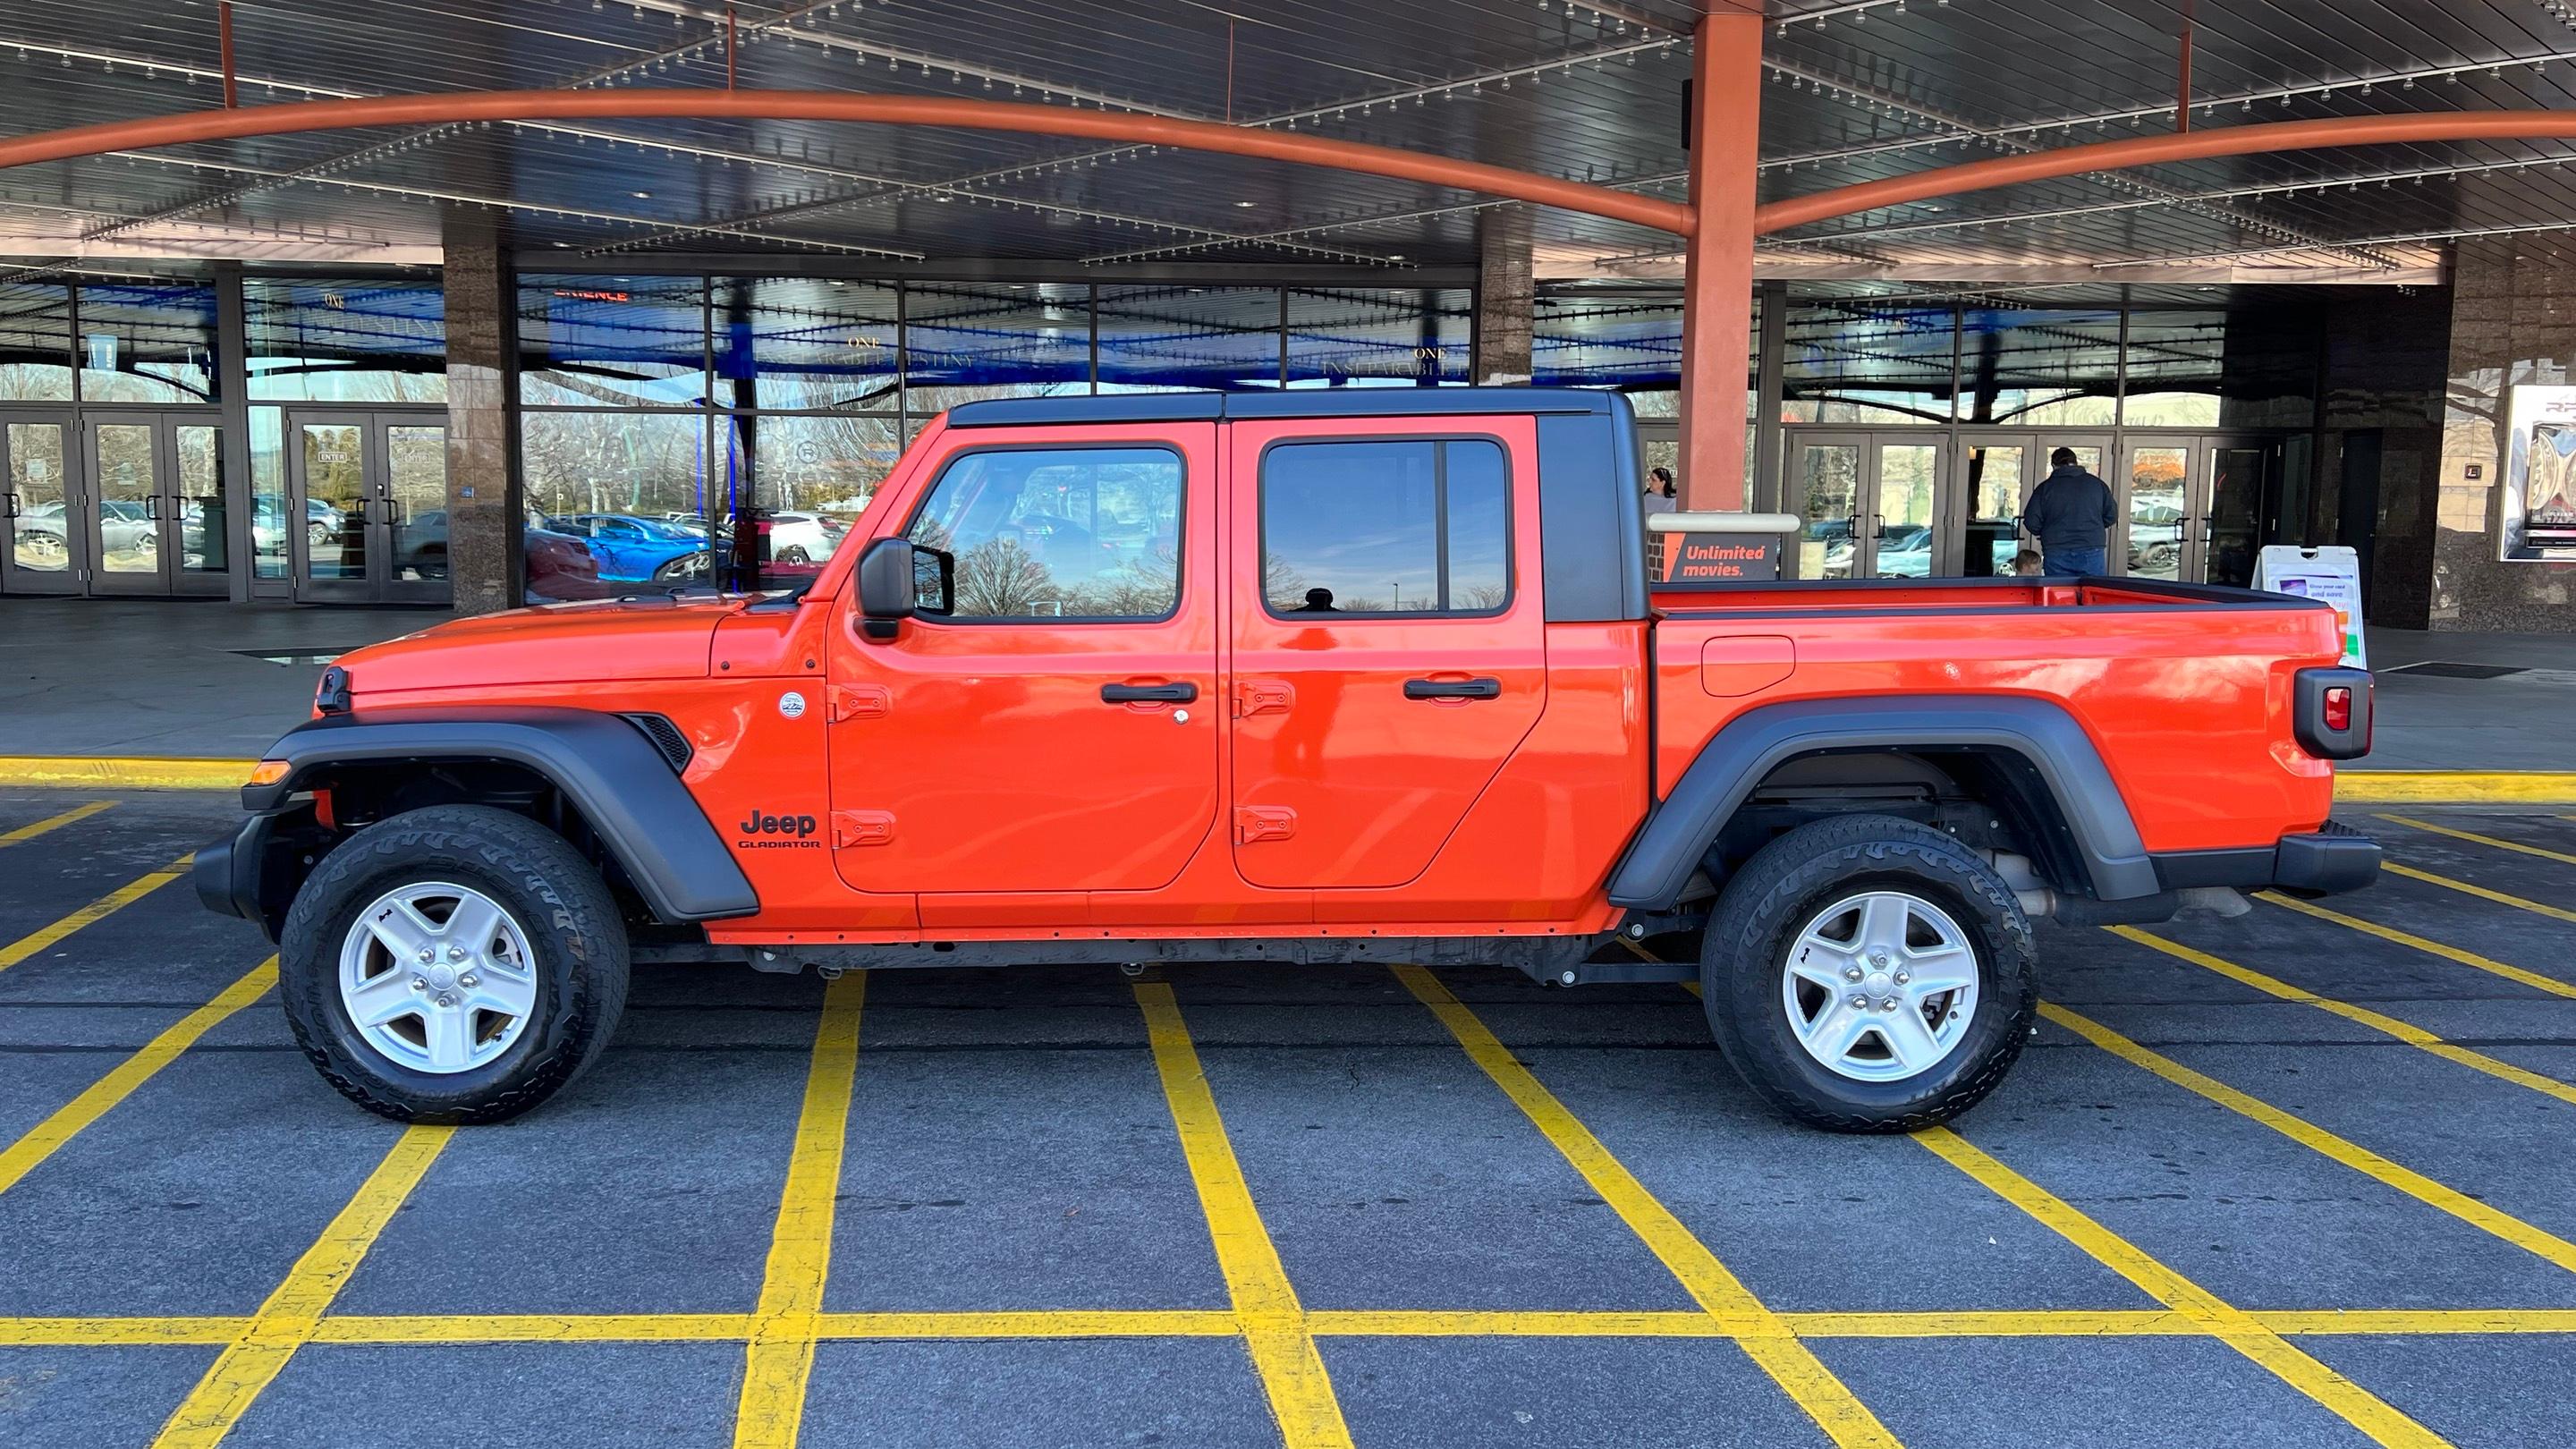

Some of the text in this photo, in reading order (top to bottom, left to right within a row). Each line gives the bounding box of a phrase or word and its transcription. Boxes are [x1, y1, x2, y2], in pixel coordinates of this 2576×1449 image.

[324, 293, 344, 309] ONE
[848, 336, 881, 350] ONE
[1414, 347, 1446, 360] ONE
[320, 453, 345, 462] ENTER
[1687, 546, 1766, 560] Unlimited
[1683, 563, 1743, 577] movies.
[741, 809, 817, 839] Jeep
[738, 841, 821, 849] GLADIATOR
